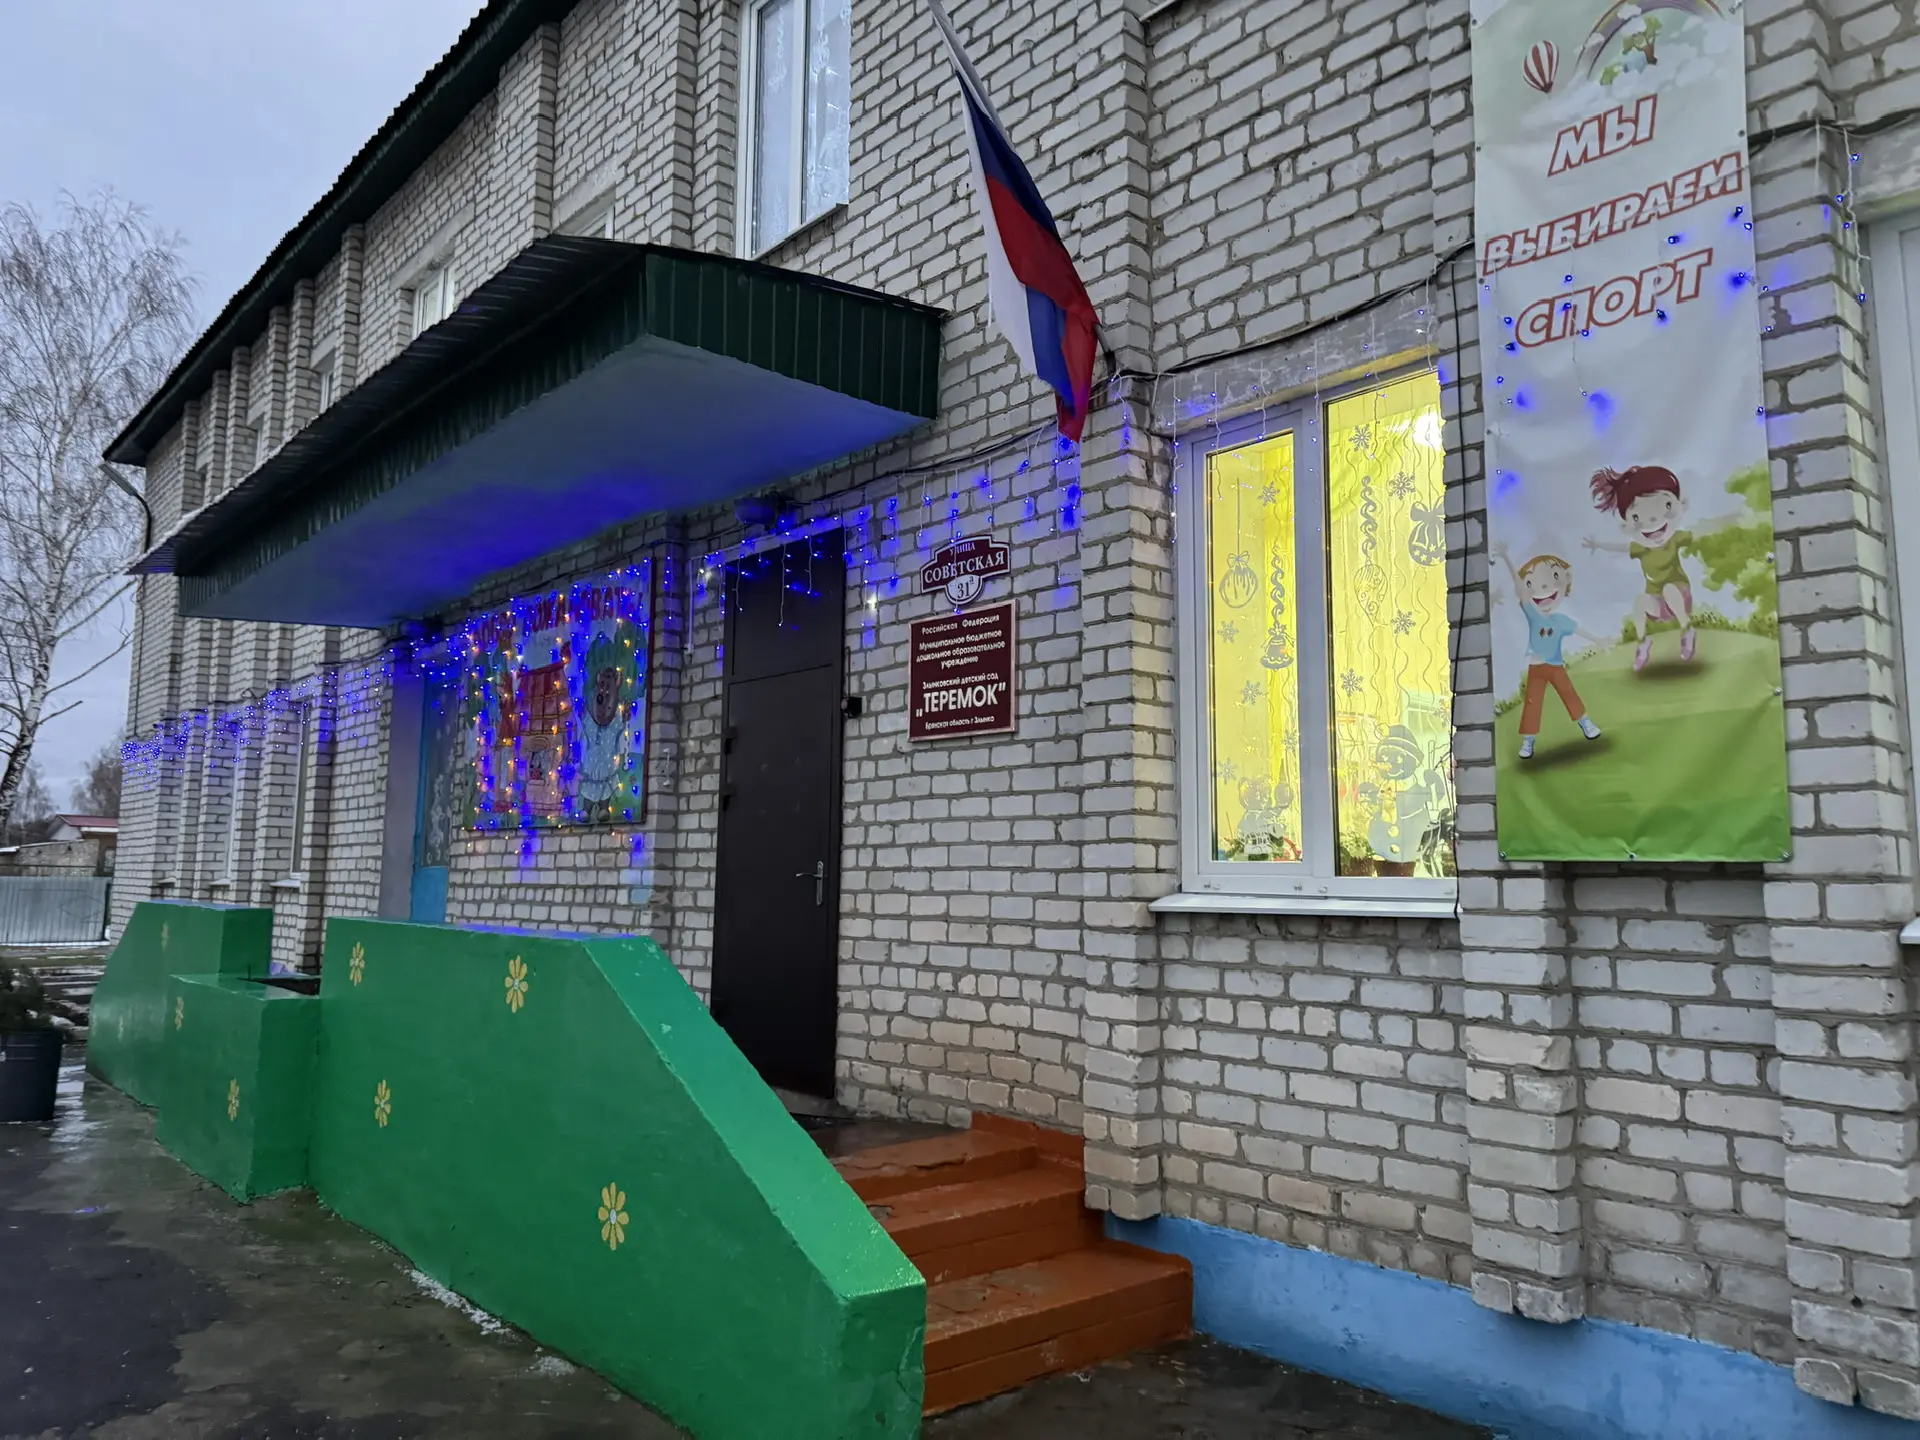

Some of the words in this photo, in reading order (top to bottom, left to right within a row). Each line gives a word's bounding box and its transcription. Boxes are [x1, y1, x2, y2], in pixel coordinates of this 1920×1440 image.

[1548, 94, 1657, 177] МЫ
[1482, 152, 1743, 276] ВЫБИРАЕМ
[1515, 248, 1714, 348] СПОРТ
[949, 542, 976, 556] УЛИЦА
[924, 550, 1005, 583] СОВЕТСКАЯ
[921, 622, 958, 635] Российская
[962, 614, 999, 628] Федерация
[916, 650, 951, 663] дошкольное
[952, 640, 1005, 657] образовательное
[919, 635, 965, 652] Муниципальное
[965, 629, 1002, 643] бюджетное
[941, 655, 979, 670] учреждение
[922, 676, 960, 690] Злынковский
[961, 673, 985, 685] детский
[987, 672, 999, 680] сад
